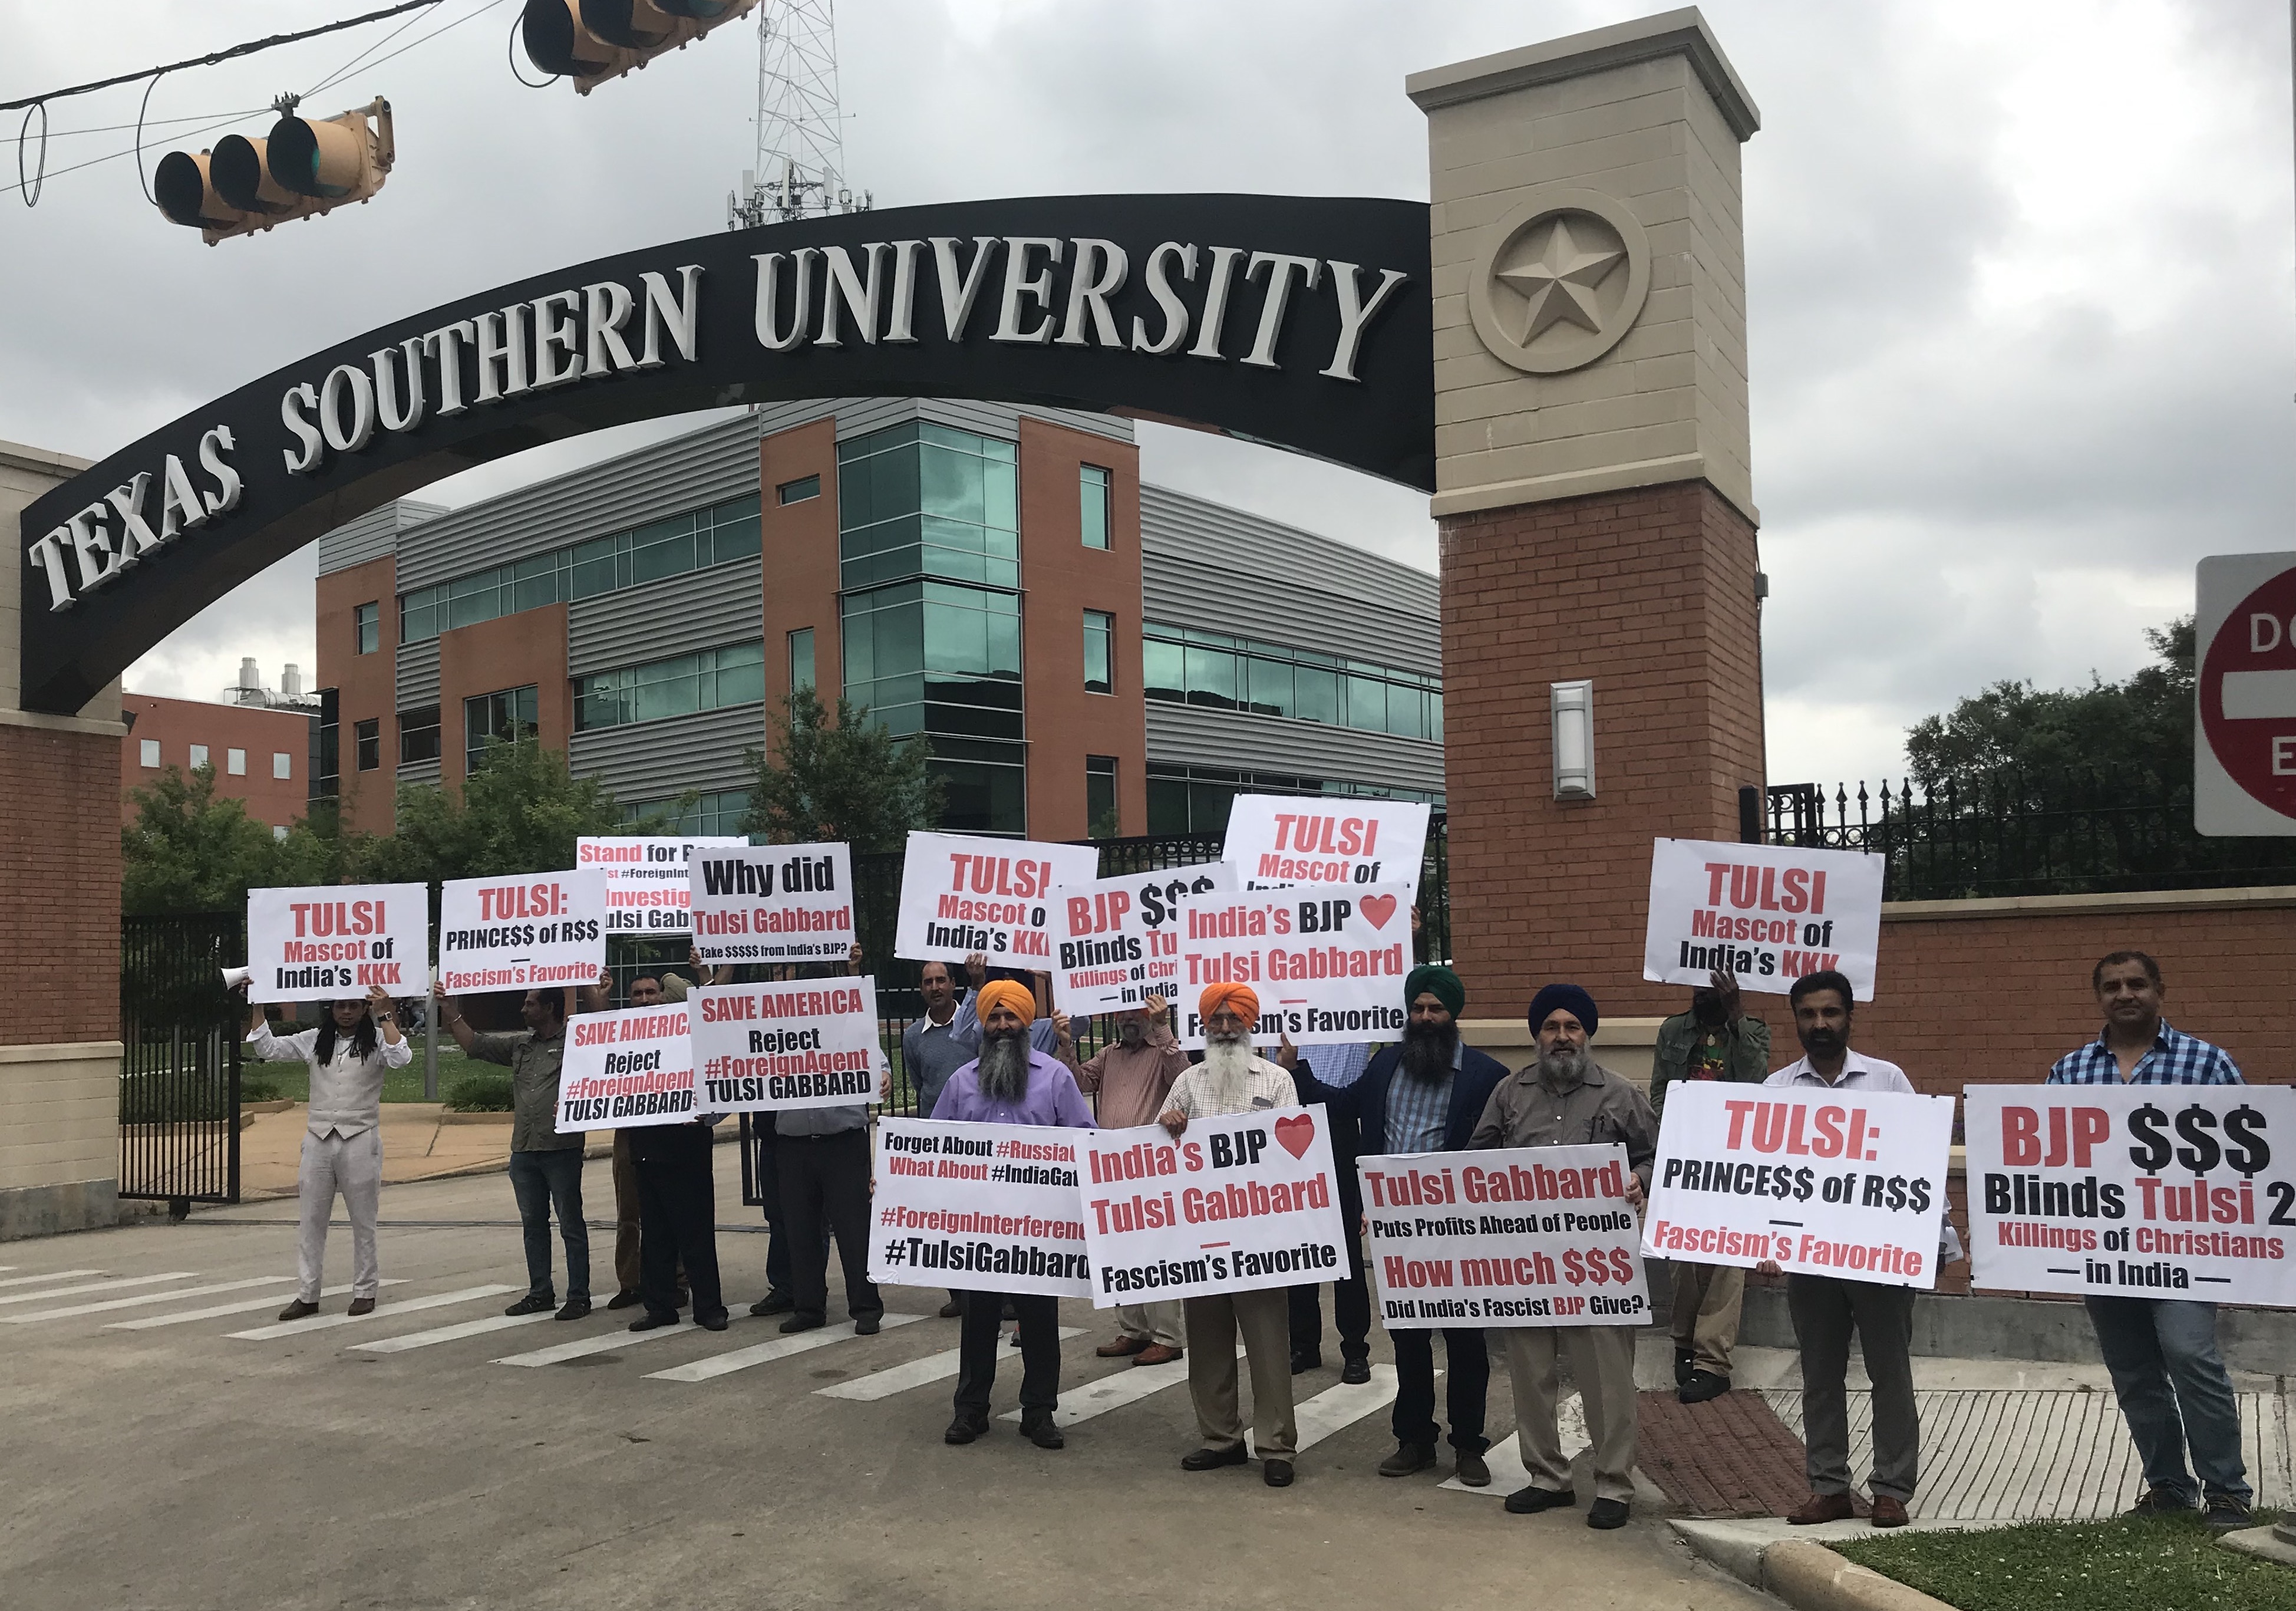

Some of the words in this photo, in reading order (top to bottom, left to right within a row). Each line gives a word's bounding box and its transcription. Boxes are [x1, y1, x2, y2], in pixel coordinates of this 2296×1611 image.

[29, 424, 244, 612] TEXAS
[281, 263, 705, 475] SOUTHERN
[750, 236, 1407, 383] UNIVERSITY
[2250, 613, 2296, 653] D
[1275, 814, 1378, 856] TULSI
[580, 844, 641, 862] Stand
[647, 844, 677, 862] for
[1258, 854, 1350, 882] Mascot
[1354, 862, 1381, 884] of
[702, 859, 774, 898] Why
[782, 855, 834, 892] did
[950, 853, 1051, 898] TULSI
[1705, 862, 1826, 914] TULSI
[478, 883, 568, 921] TULSI:
[938, 894, 1027, 925] Mascot
[1031, 907, 1047, 927] o
[1067, 891, 1130, 937] BJP
[290, 901, 385, 937] TULSI
[446, 924, 535, 951] PRINCE$$
[539, 922, 559, 943] of
[562, 918, 599, 943] R$$
[648, 910, 691, 928] Gab
[693, 908, 748, 935] Tulsi
[754, 905, 850, 933] Gabbard
[1189, 904, 1291, 940] India's
[1299, 900, 1351, 933] BJP
[1692, 909, 1796, 944] Mascot
[1803, 920, 1833, 947] of
[284, 940, 367, 963] Mascot
[372, 938, 393, 960] of
[700, 947, 723, 958] Take
[725, 945, 758, 958] $$$$$
[761, 944, 784, 957] from
[786, 943, 822, 956] India's
[823, 943, 847, 955] BJP?
[926, 922, 1007, 952] India's
[1060, 935, 1142, 970] Blinds
[276, 965, 352, 989] India's
[357, 963, 401, 986] KKK
[446, 966, 526, 990] Fascism's
[529, 961, 597, 982] Favorite
[1185, 951, 1259, 984] Tulsi
[1268, 943, 1403, 981] Gabbard
[1680, 941, 1774, 976] India's
[1782, 950, 1839, 978] KKK
[1070, 969, 1127, 989] Killings
[1130, 964, 1144, 980] of
[701, 996, 757, 1022] SAVE
[762, 989, 863, 1018] AMERICA
[1121, 987, 1136, 1003] in
[575, 1021, 616, 1047] SAVE
[619, 1013, 691, 1041] AMERIC
[1308, 1006, 1404, 1032] Favorite
[749, 1028, 821, 1053] Reject
[605, 1049, 661, 1075] Reject
[705, 1048, 870, 1078] #ForeignAgent
[566, 1069, 694, 1099] #ForeignAgent
[705, 1076, 764, 1103] TULSI
[769, 1070, 871, 1098] GABBARD
[565, 1098, 611, 1122] TULSI
[612, 1090, 692, 1118] GABBARD
[885, 1132, 939, 1154] Forget
[943, 1136, 992, 1157] About
[1725, 1100, 1880, 1161] TULSI:
[2001, 1106, 2110, 1168] BJP
[2127, 1102, 2271, 1178] $$$
[890, 1157, 934, 1177] What
[937, 1160, 988, 1181] About
[1089, 1139, 1203, 1184] India's
[1209, 1129, 1266, 1169] BJP
[1364, 1168, 1456, 1208] Tulsi
[1462, 1160, 1624, 1204] Gabbard
[1662, 1158, 1814, 1203] PRINCE$$
[1822, 1173, 1857, 1204] of
[1862, 1174, 1931, 1215] R$$
[1984, 1173, 2126, 1219] Blinds
[2135, 1178, 2255, 1225] Tulsi
[1091, 1191, 1176, 1235] Tulsi
[1182, 1172, 1330, 1224] Gabbard
[1372, 1220, 1412, 1238] Puts
[1414, 1217, 1476, 1236] Profits
[1479, 1214, 1539, 1235] Ahead
[1542, 1213, 1561, 1232] of
[1563, 1211, 1631, 1233] People
[1998, 1221, 2097, 1252] Killings
[2103, 1227, 2129, 1251] of
[2136, 1227, 2284, 1259] Christians
[1653, 1220, 1792, 1262] Fascism's
[1798, 1234, 1922, 1277] Favorite
[1101, 1254, 1228, 1293] Fascism's
[1232, 1243, 1337, 1278] Favorite
[1384, 1255, 1453, 1288] How
[1460, 1251, 1557, 1286] much
[1562, 1246, 1633, 1287] $$$
[2086, 1259, 2111, 1284] in
[2118, 1260, 2189, 1289] India
[1386, 1300, 1414, 1319] Did
[1420, 1299, 1480, 1318] India's
[1483, 1297, 1550, 1316] Fascist
[1553, 1296, 1585, 1315] BJP
[1589, 1294, 1644, 1315] Give?
